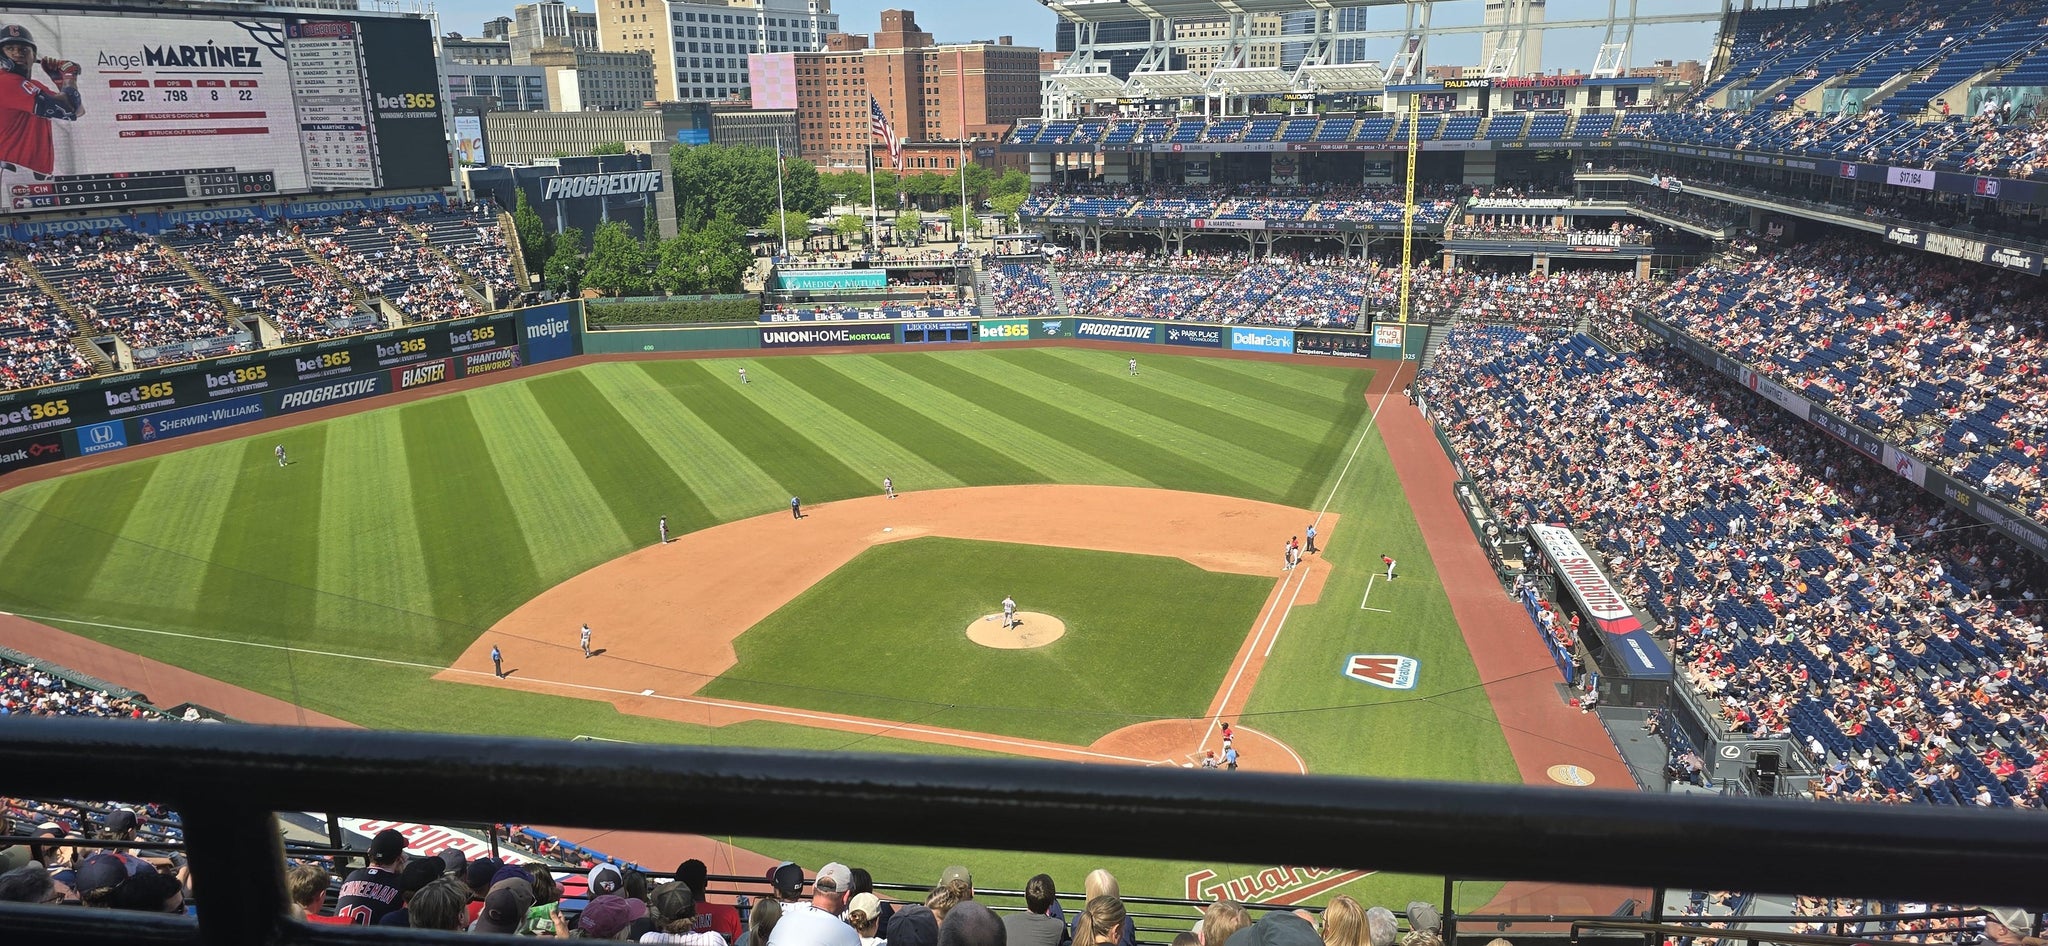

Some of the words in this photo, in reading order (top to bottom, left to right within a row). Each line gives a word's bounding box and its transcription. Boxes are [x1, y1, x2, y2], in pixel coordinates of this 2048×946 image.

[303, 24, 348, 37] GUARDIANS
[97, 50, 144, 70] Angel
[144, 39, 262, 68] MARTÍNEZ
[1494, 77, 1536, 88] PENNANT
[1541, 75, 1584, 87] DISTRICT
[118, 90, 144, 102] .262
[163, 90, 188, 102] .798
[211, 90, 218, 101] 8
[238, 90, 253, 101] 22
[376, 92, 436, 108] bet365
[546, 172, 660, 199] PROGRESSIVE
[1900, 172, 1922, 184] $17,164
[306, 200, 367, 212] HONDA
[384, 193, 440, 206] HONDA
[1529, 198, 1570, 208] BREWERY
[186, 208, 255, 222] HONDA
[46, 218, 127, 233] HONDA
[1567, 234, 1583, 245] THE
[1585, 234, 1620, 247] CORNER
[450, 326, 494, 344] bet365
[527, 318, 568, 338] meijer
[980, 324, 1028, 337] bet365
[1078, 323, 1152, 339] PROGRESSIVE
[1377, 328, 1397, 338] drug
[376, 338, 426, 358] bet365
[296, 351, 350, 372] bet365
[466, 350, 510, 365] PHANTOM
[467, 360, 510, 375] FIREWORKS
[205, 366, 267, 388] bet365
[402, 363, 445, 388] BLASTER
[37, 382, 80, 396] PROGRESSIVE
[105, 381, 174, 406] bet365
[281, 378, 376, 410] PROGRESSIVE
[108, 404, 137, 415] WINNING
[141, 398, 175, 410] EVERYTHING
[33, 417, 72, 429] EVERYTHING
[84, 441, 123, 453] HONDA
[1854, 434, 1859, 444] 8
[1870, 443, 1878, 455] 22
[1945, 484, 1970, 506] bet365
[1976, 501, 2004, 525] WINNING
[2008, 520, 2048, 550] EVERYTHING
[1560, 558, 1624, 612] GUARDIANS
[1396, 659, 1412, 686] Marathon
